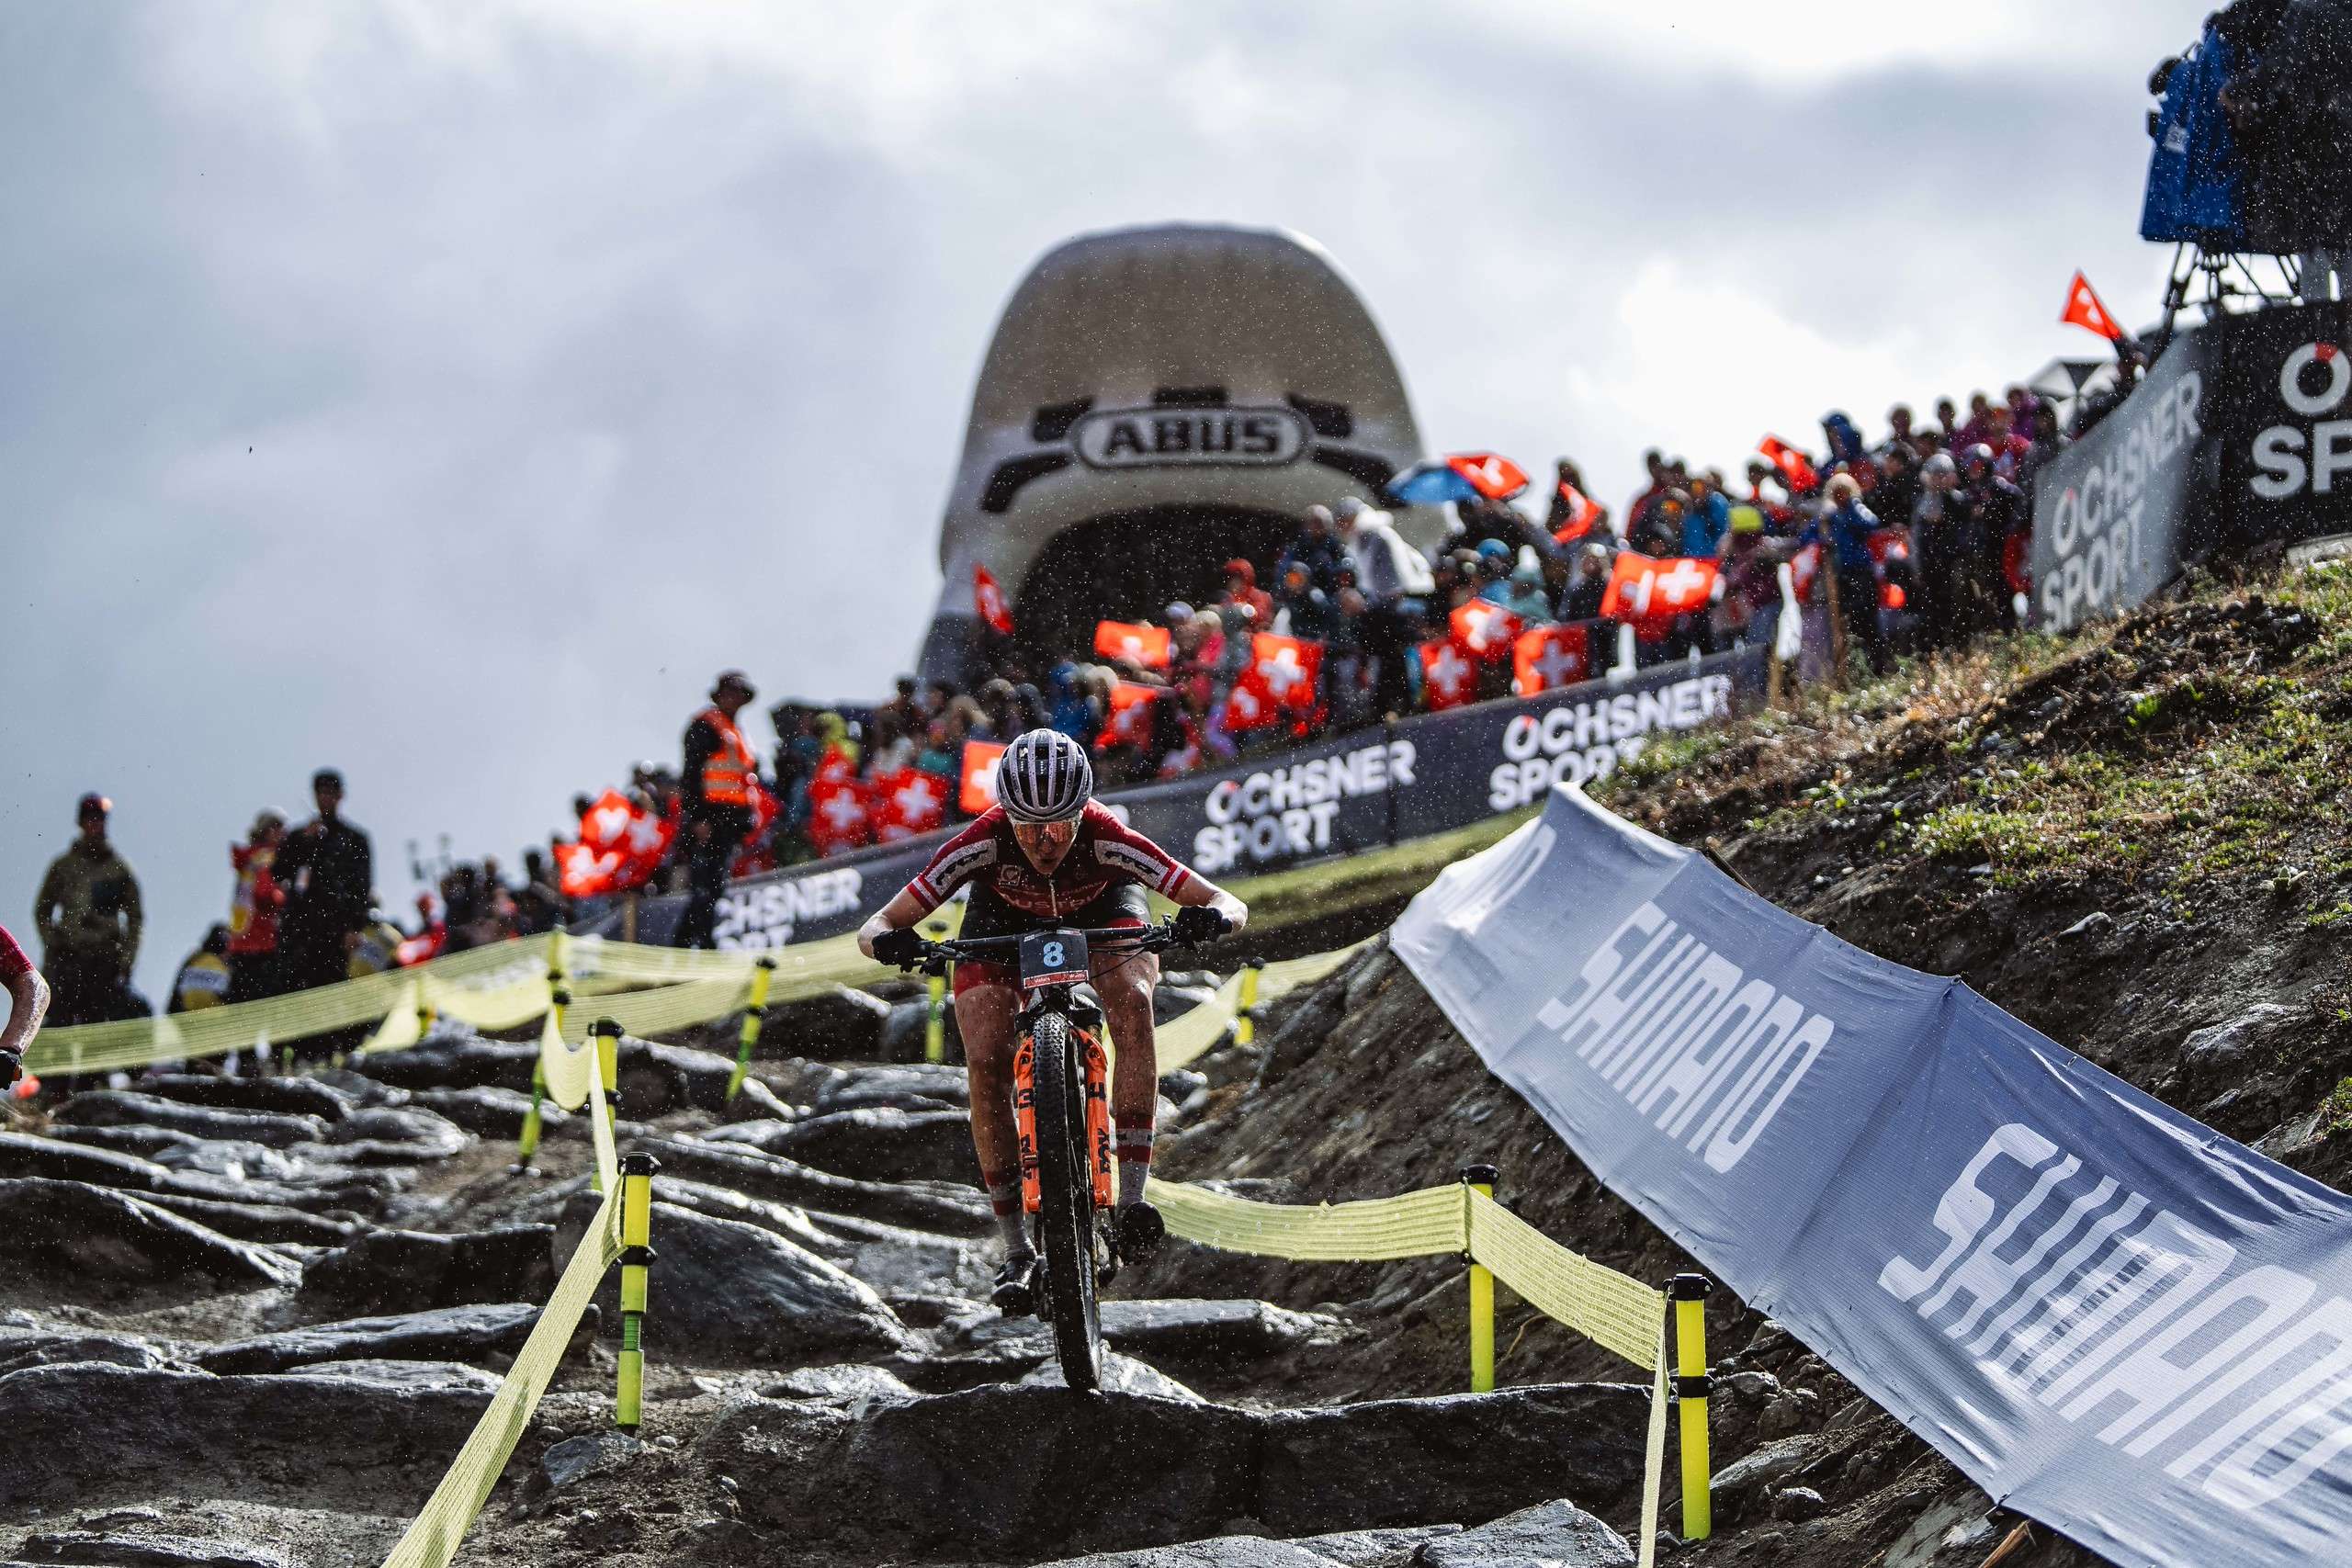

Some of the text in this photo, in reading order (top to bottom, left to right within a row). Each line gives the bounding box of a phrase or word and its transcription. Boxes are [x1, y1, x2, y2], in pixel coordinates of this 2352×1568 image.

[1106, 418, 1282, 456] ABUS
[2052, 369, 2202, 558] OCHSNER
[2041, 497, 2145, 636] SPORT
[1502, 673, 1735, 762] OCHSNER
[1204, 739, 1418, 825] OCHSNER
[1192, 799, 1341, 874] SPORT
[1043, 941, 1065, 968] 8
[1536, 900, 1836, 1175] SHIMANO
[1876, 1122, 2352, 1510] SHIMANO
